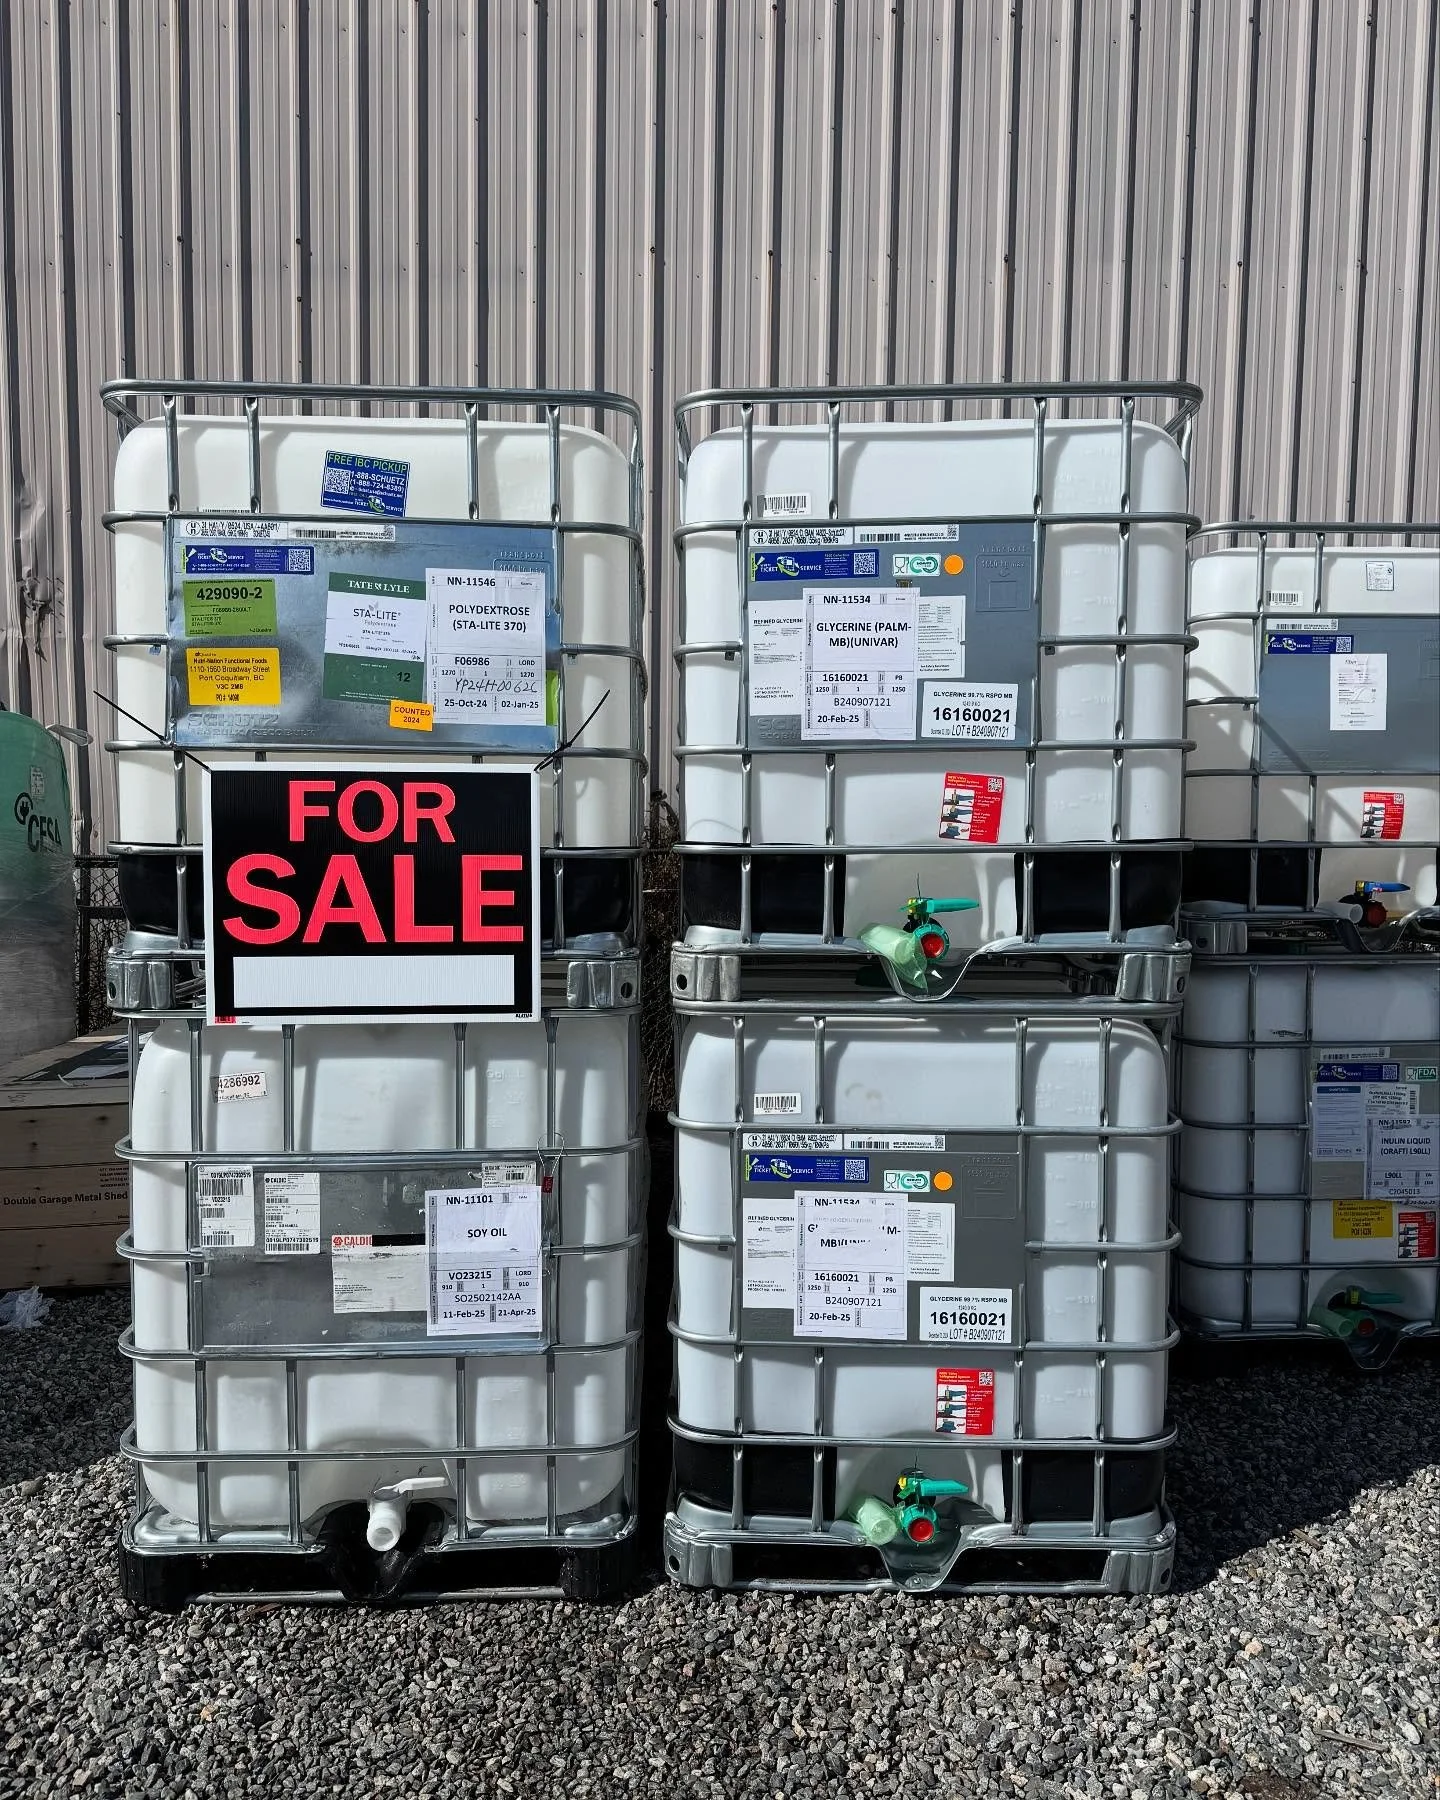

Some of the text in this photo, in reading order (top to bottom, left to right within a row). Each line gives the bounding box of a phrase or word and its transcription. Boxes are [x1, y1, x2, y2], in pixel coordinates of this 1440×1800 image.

[328, 454, 408, 473] FREE IBC PICKUP
[348, 579, 374, 591] TATE
[383, 581, 410, 594] LYLE
[447, 577, 496, 587] NN-11546
[197, 587, 263, 601] 429090-2
[823, 595, 871, 604] NN-11534
[449, 604, 530, 616] POLYDEXTROSE
[453, 619, 527, 633] (STA-LITE 370)
[816, 621, 912, 633] GLYCERINE (PALM-
[829, 636, 899, 649] MB)(UNIVAR)
[455, 656, 490, 666] F06986
[253, 674, 265, 682] BC
[396, 671, 411, 683] 12
[822, 673, 869, 682] 16160021
[444, 699, 539, 709] 25-Oct-24 02-Jan-25
[834, 697, 892, 707] B240907121
[394, 705, 431, 717] COUNTED
[933, 707, 1010, 723] 16160021
[403, 715, 420, 724] 2024
[817, 714, 860, 723] 20-Feb-25
[951, 724, 966, 736] LOT
[289, 780, 456, 843] FOR
[223, 853, 524, 945] SALE
[1417, 1068, 1436, 1077] FDA
[1381, 1137, 1431, 1145] INULIN LIQUID
[3, 1191, 128, 1206] Double Garage Metal Shed
[446, 1194, 493, 1205] NN-11101
[467, 1227, 507, 1239] SOY OIL
[448, 1270, 492, 1281] VO23215
[814, 1272, 860, 1283] 16160021
[442, 1283, 453, 1291] 910
[518, 1280, 530, 1288] 910
[454, 1292, 522, 1303] SO2502142AA
[825, 1296, 883, 1308] B240907121
[443, 1308, 537, 1320] 11-Feb-25 21-Apr-25
[809, 1312, 851, 1323] 20-Feb-25
[930, 1311, 1005, 1327] 16160021
[949, 1327, 964, 1341] LOT
